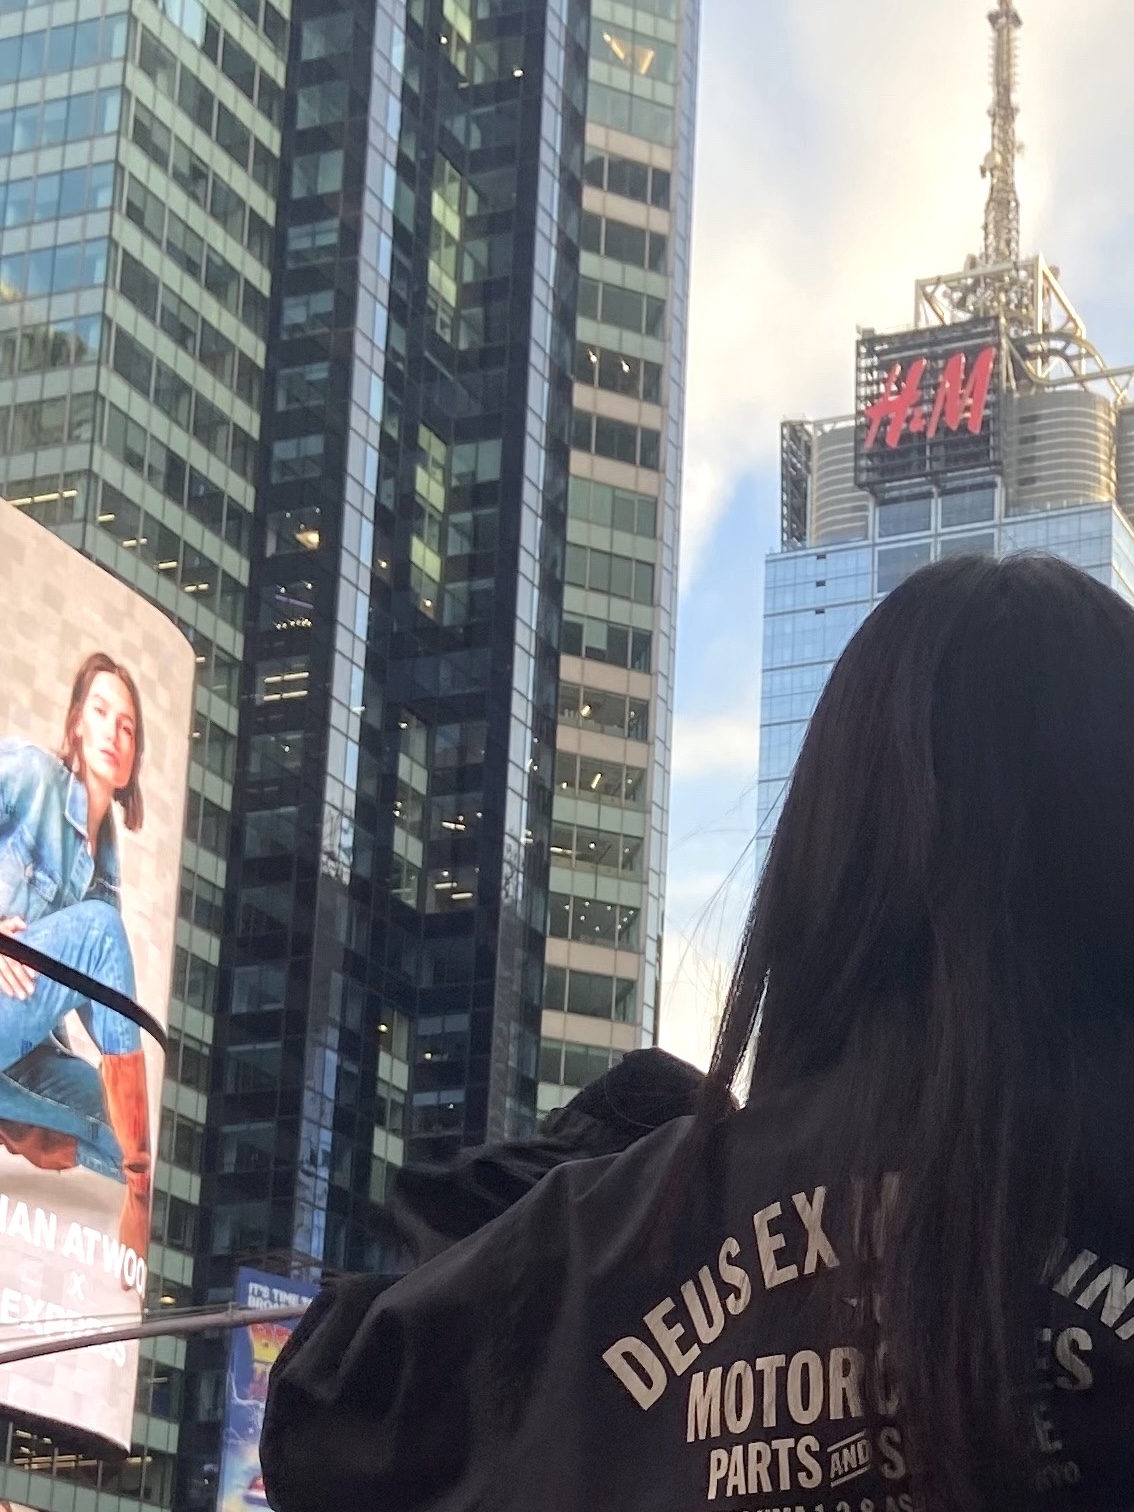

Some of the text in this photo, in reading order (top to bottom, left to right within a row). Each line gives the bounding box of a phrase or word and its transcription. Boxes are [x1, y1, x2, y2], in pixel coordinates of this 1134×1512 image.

[864, 345, 997, 450] H&M
[602, 1236, 751, 1411] DEUS
[753, 1185, 840, 1289] EX
[708, 1435, 823, 1500] PARTS
[830, 1439, 872, 1479] AND
